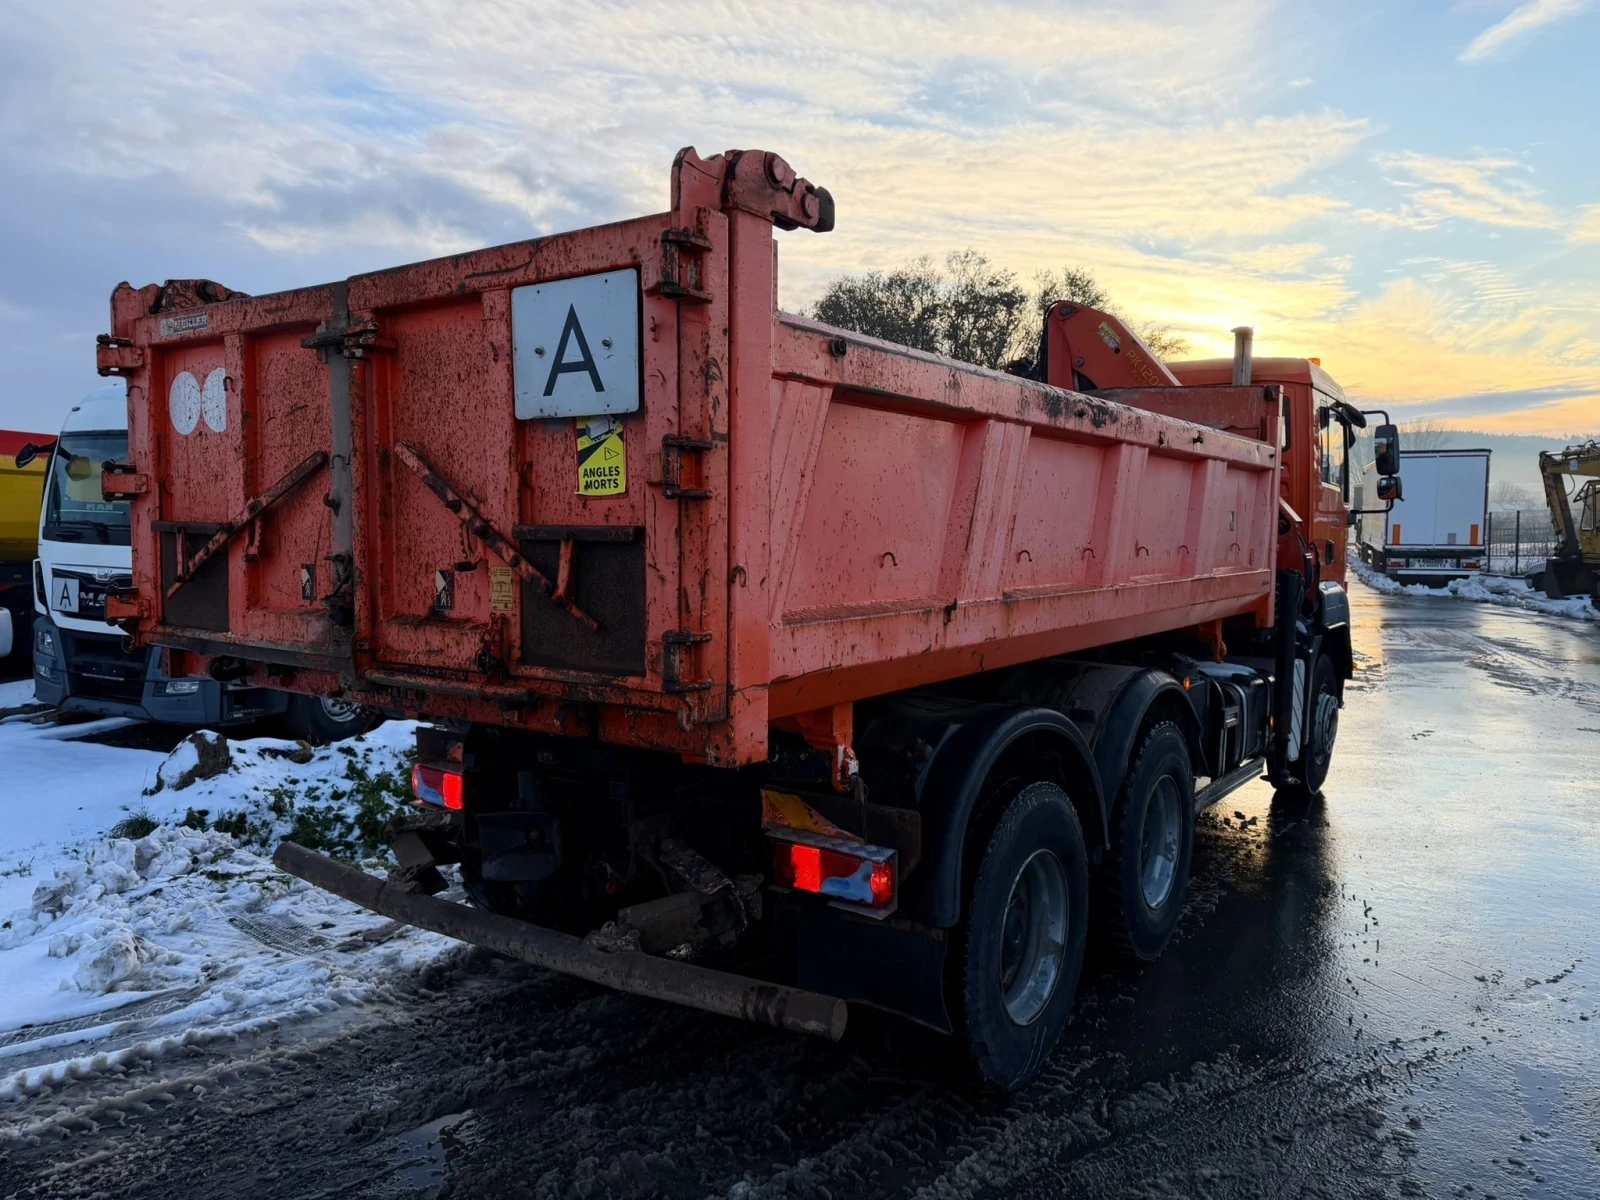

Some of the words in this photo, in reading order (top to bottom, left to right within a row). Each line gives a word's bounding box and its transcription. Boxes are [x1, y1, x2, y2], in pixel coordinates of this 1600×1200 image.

[542, 303, 605, 397] A
[583, 466, 620, 478] ANGLES
[584, 478, 619, 490] MORTS
[60, 581, 71, 606] A
